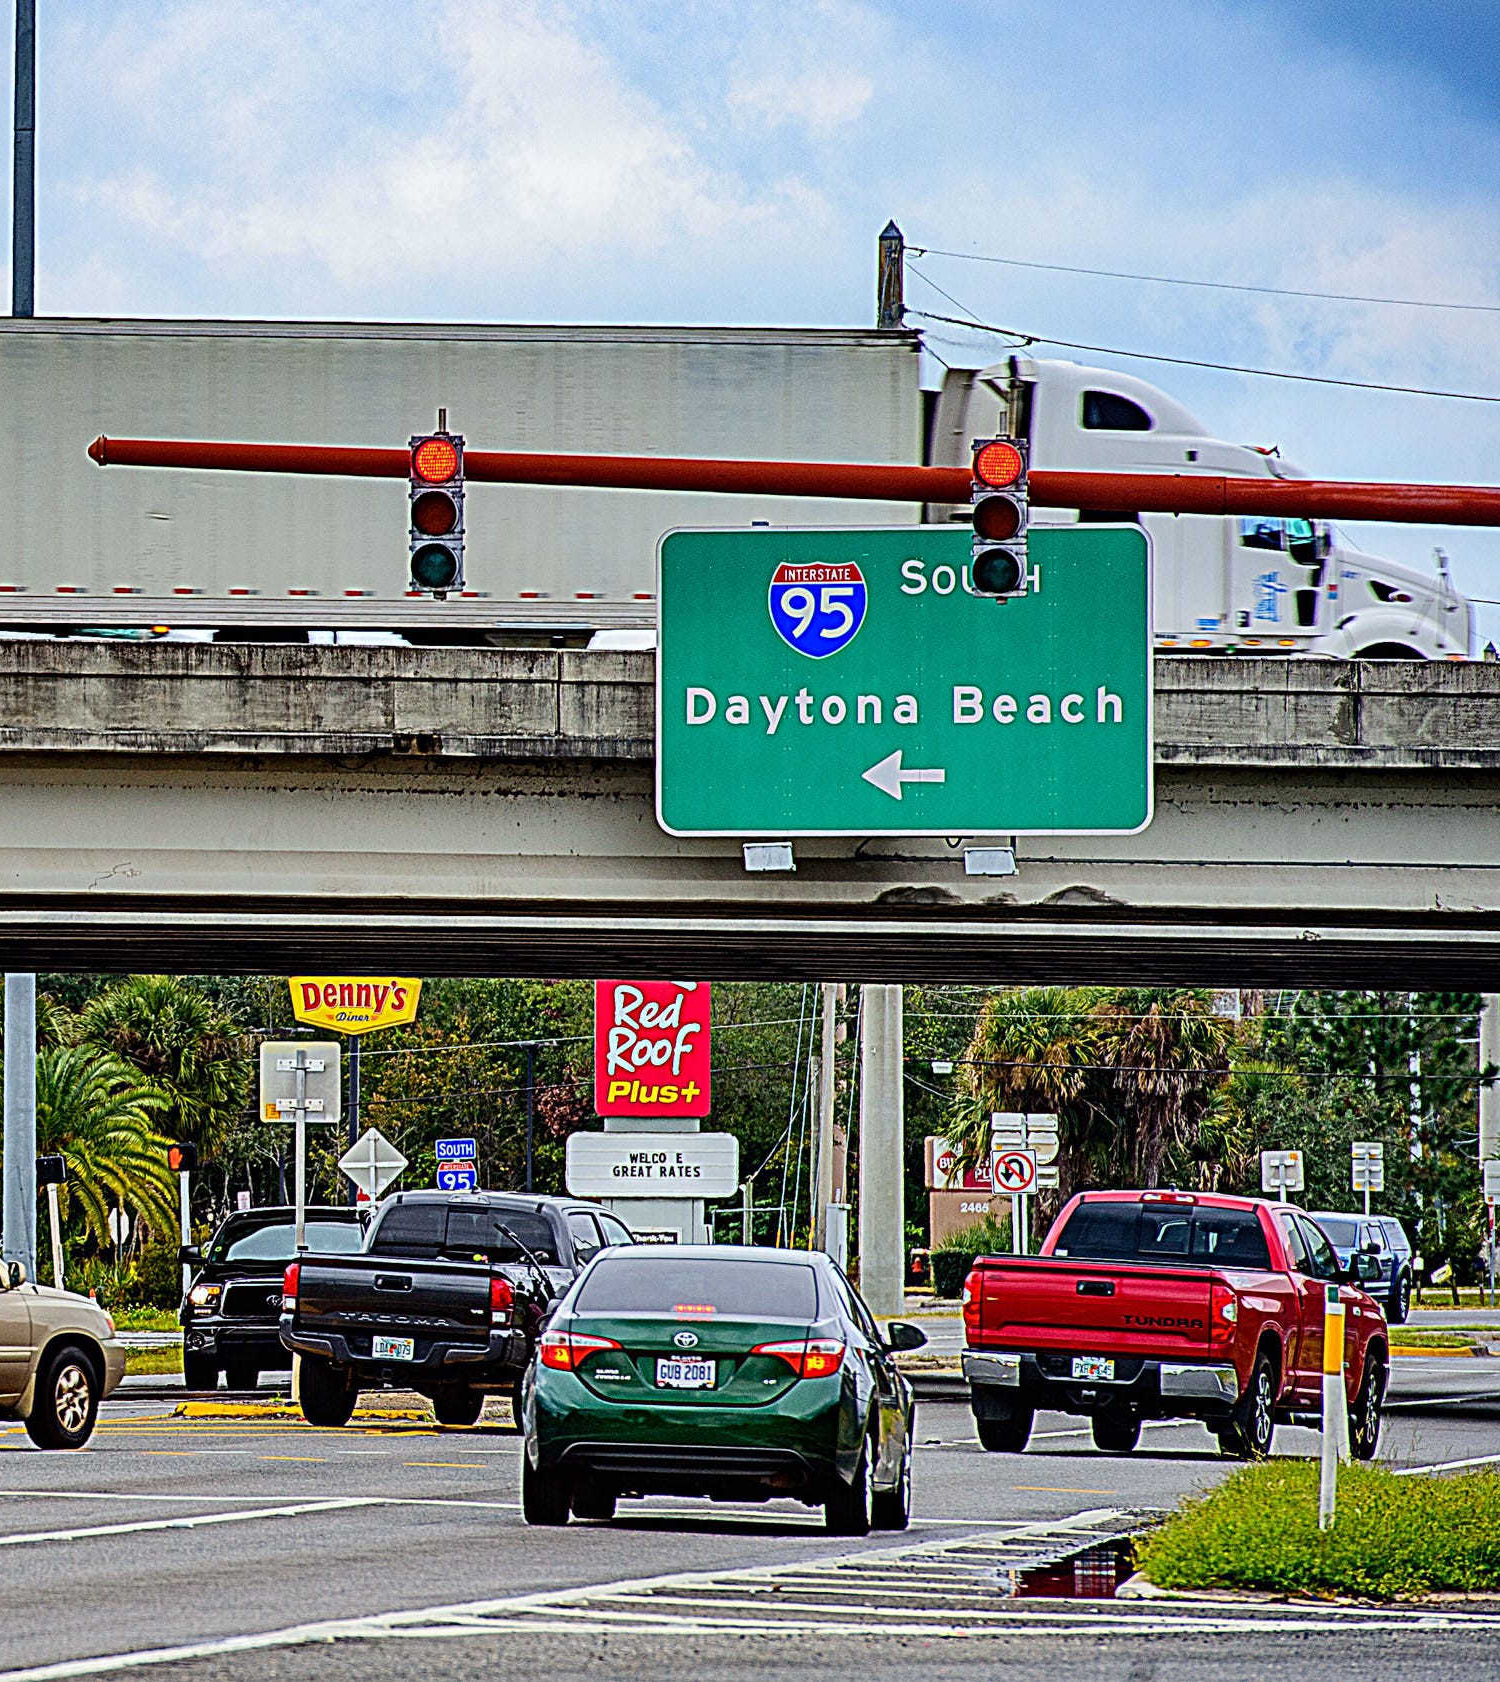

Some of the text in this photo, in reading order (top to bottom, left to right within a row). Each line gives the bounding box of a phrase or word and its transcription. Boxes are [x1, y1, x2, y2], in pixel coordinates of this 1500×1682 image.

[784, 568, 851, 582] INTERSTATE
[781, 587, 854, 639] 95
[686, 684, 1124, 735] Daytona Beach
[300, 980, 408, 1015] Denny's
[614, 984, 685, 1030] Red
[335, 1011, 370, 1022] Diner
[606, 1023, 701, 1076] Roof
[439, 1143, 473, 1156] SOUTH
[613, 1166, 701, 1178] GREAT RATES
[443, 1173, 470, 1190] 95
[338, 1311, 450, 1327] TACOMA
[1123, 1314, 1204, 1329] TUNDRA
[660, 1364, 711, 1381] GUB 2081
